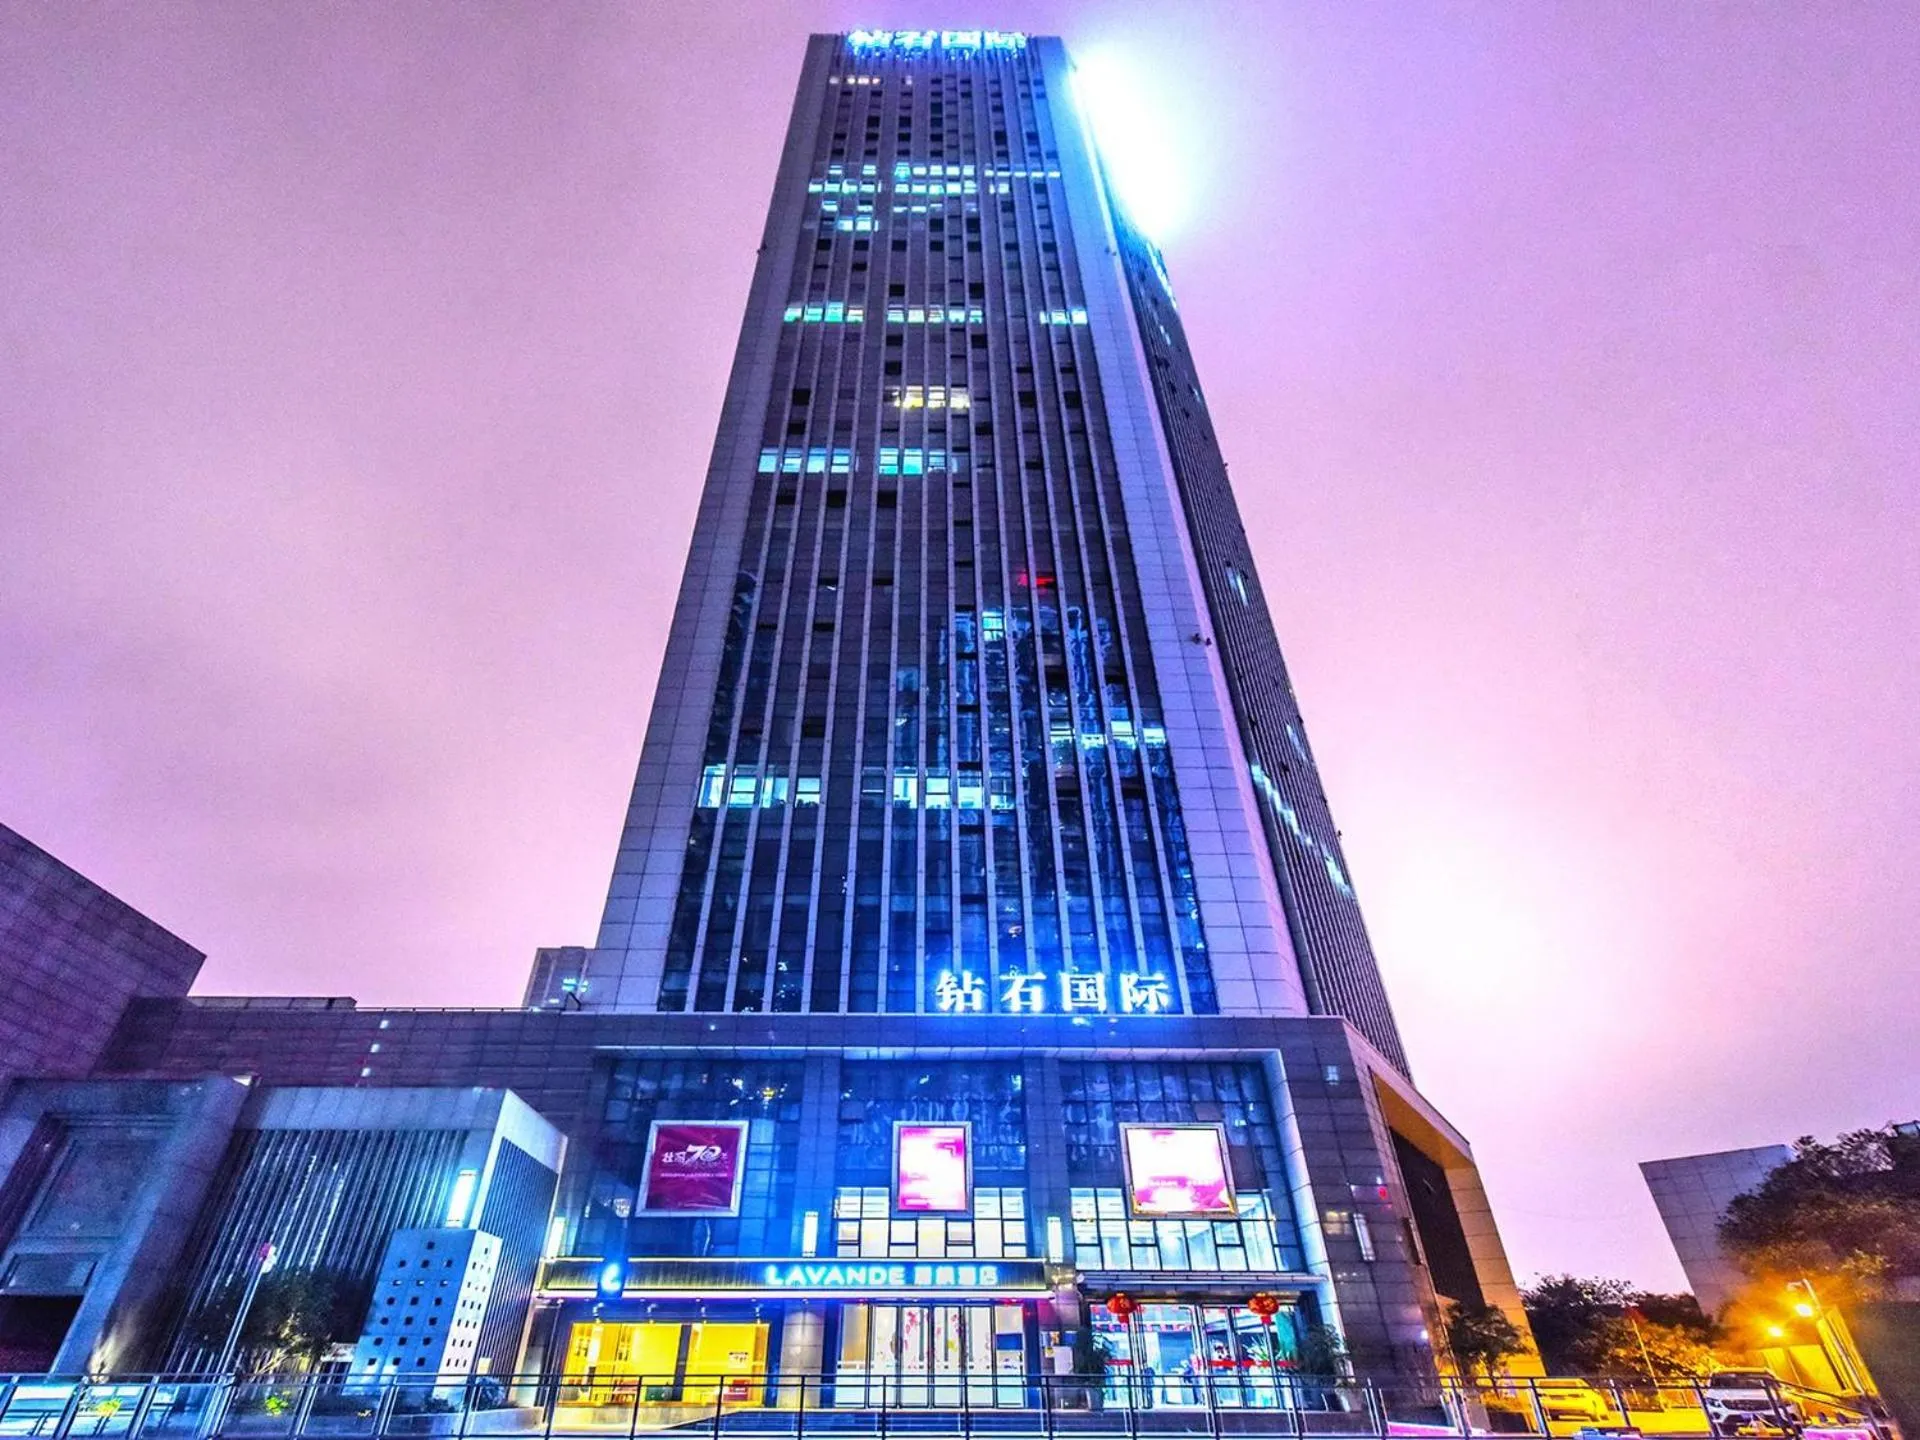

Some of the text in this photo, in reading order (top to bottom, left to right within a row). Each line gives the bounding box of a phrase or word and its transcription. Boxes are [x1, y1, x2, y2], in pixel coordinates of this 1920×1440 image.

[936, 970, 1170, 1013] 钻石国际
[766, 1265, 905, 1287] LAVANDE
